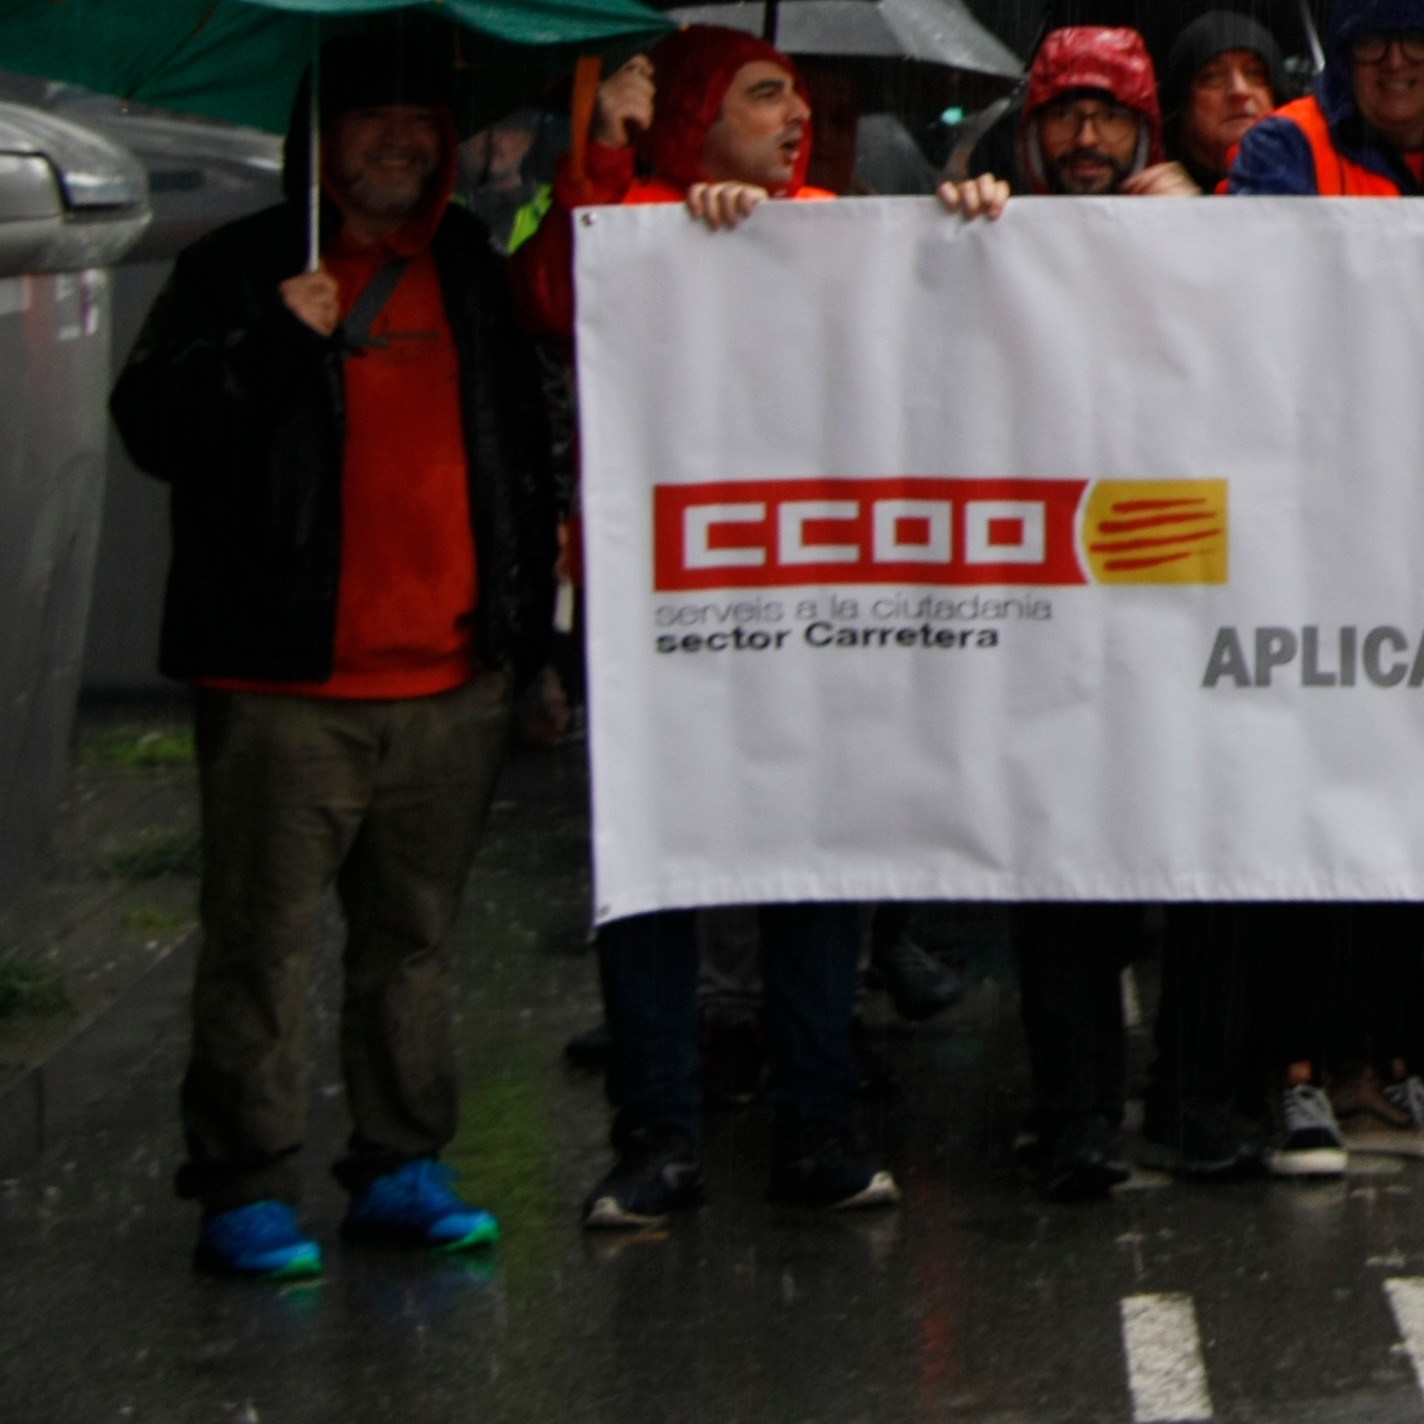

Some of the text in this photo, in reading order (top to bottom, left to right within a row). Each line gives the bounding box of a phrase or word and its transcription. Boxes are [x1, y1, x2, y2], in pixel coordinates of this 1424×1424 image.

[683, 500, 1046, 569] CCOO
[655, 592, 1053, 627] serveis a la ciutadania
[656, 622, 998, 654] sector Carretera
